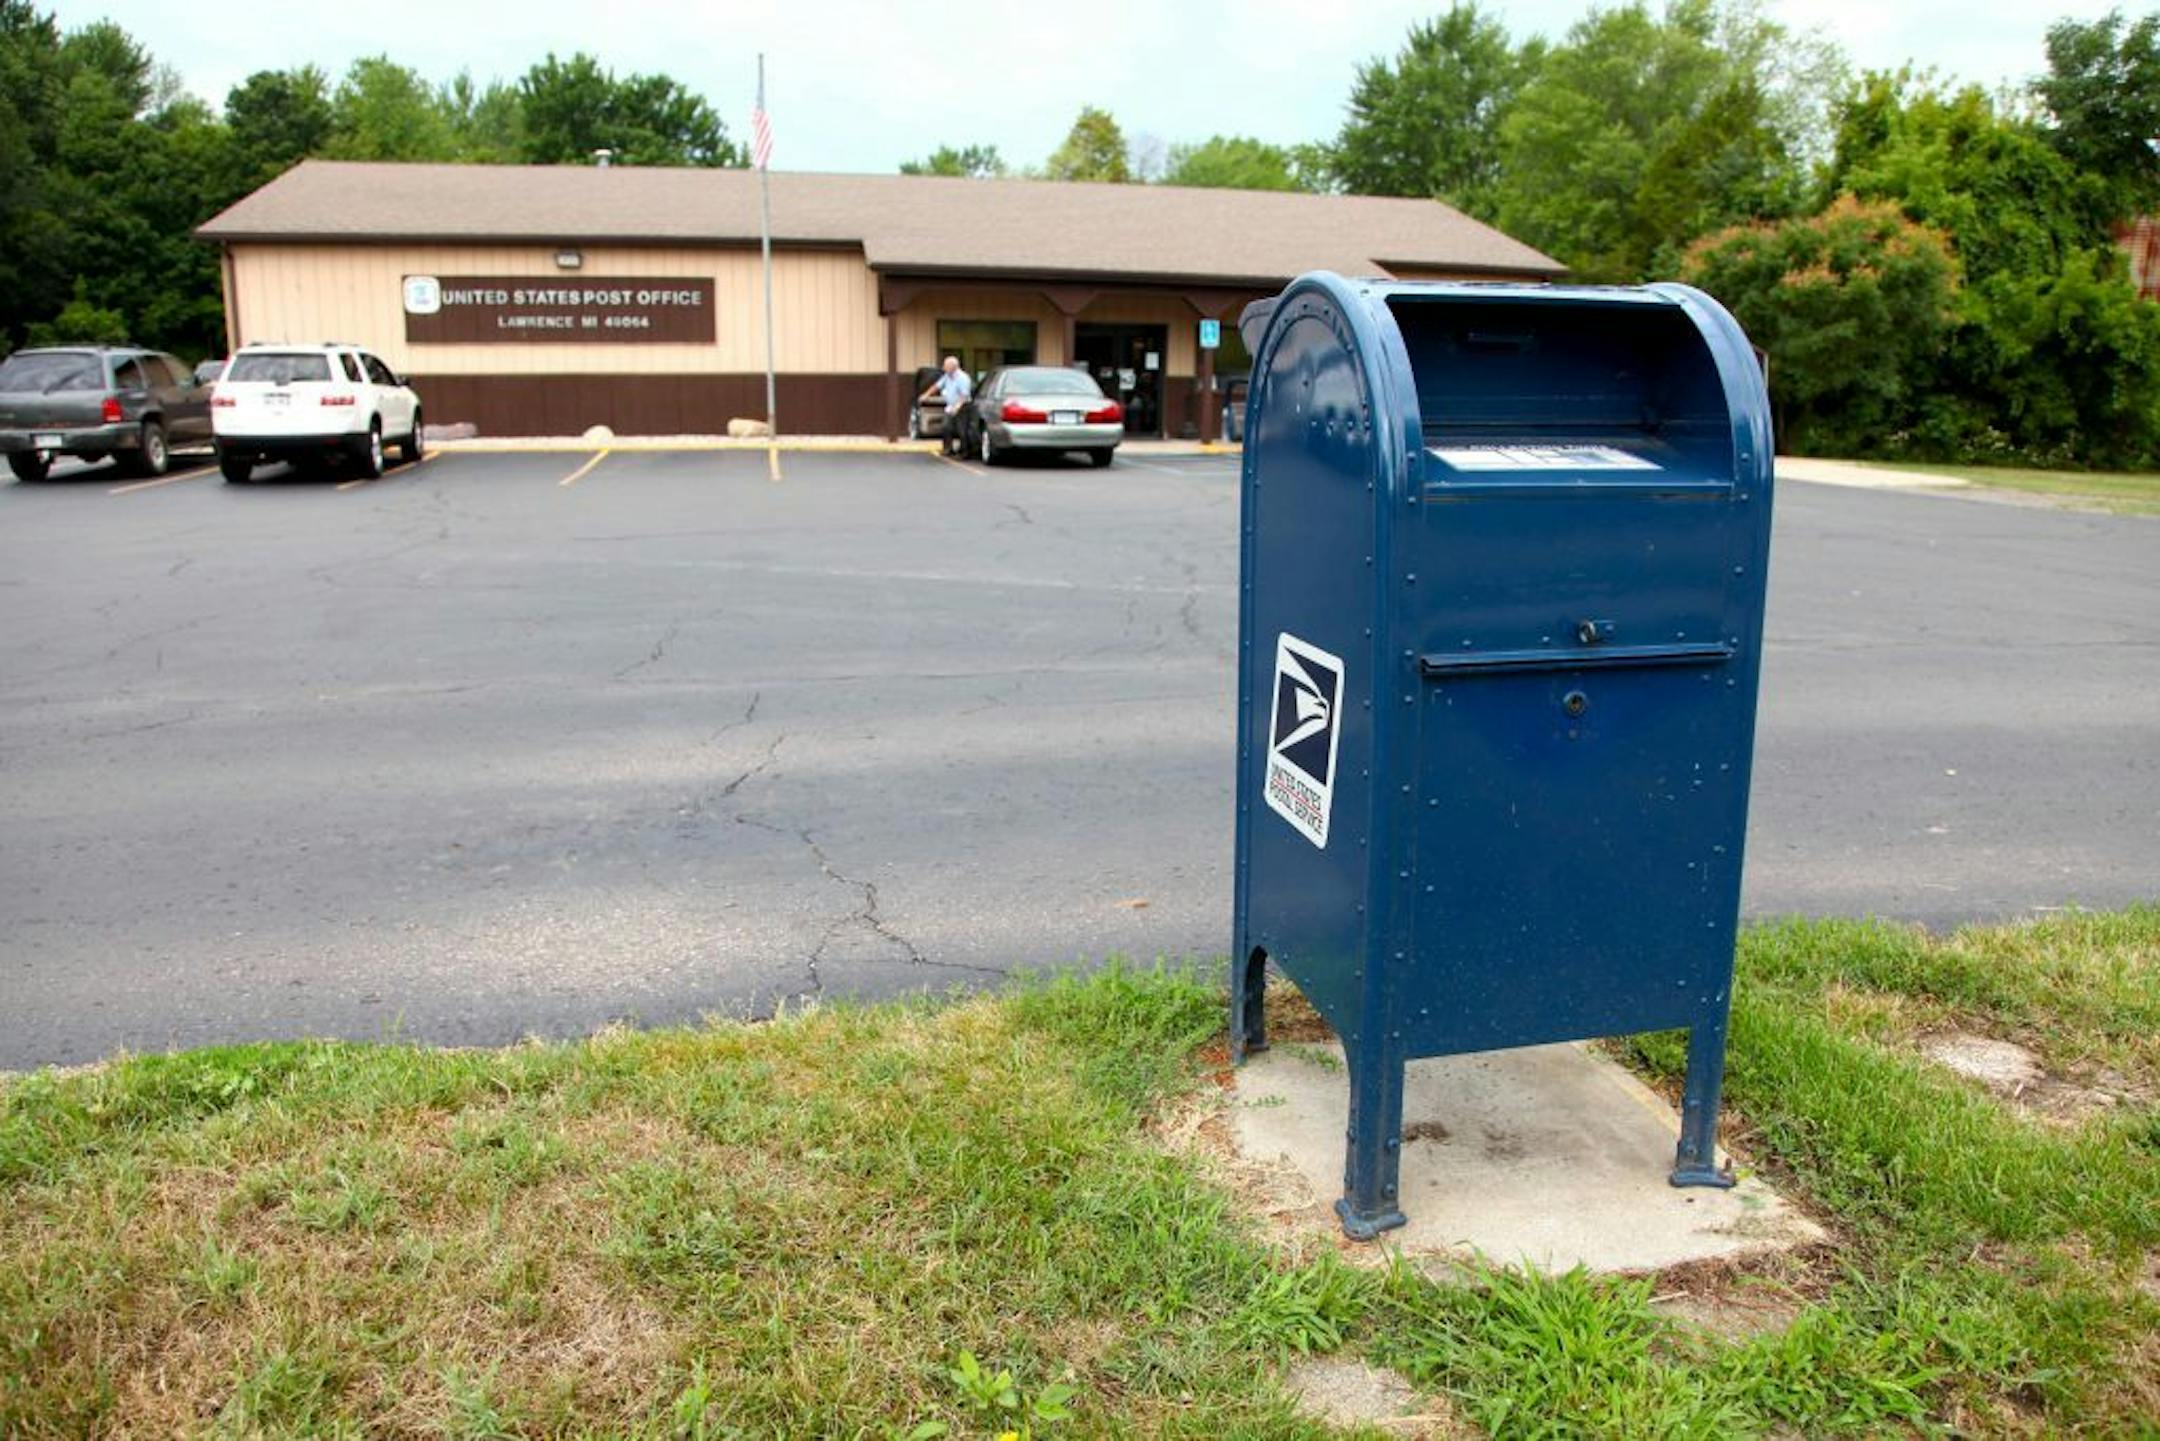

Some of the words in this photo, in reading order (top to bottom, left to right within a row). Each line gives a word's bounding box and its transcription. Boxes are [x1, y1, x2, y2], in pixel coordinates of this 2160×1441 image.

[442, 290, 508, 304] UNITED
[514, 290, 581, 304] STATES
[583, 290, 633, 304] POST
[637, 290, 702, 304] OFFICE
[498, 315, 574, 327] LAWRENCE
[581, 315, 598, 327] MI
